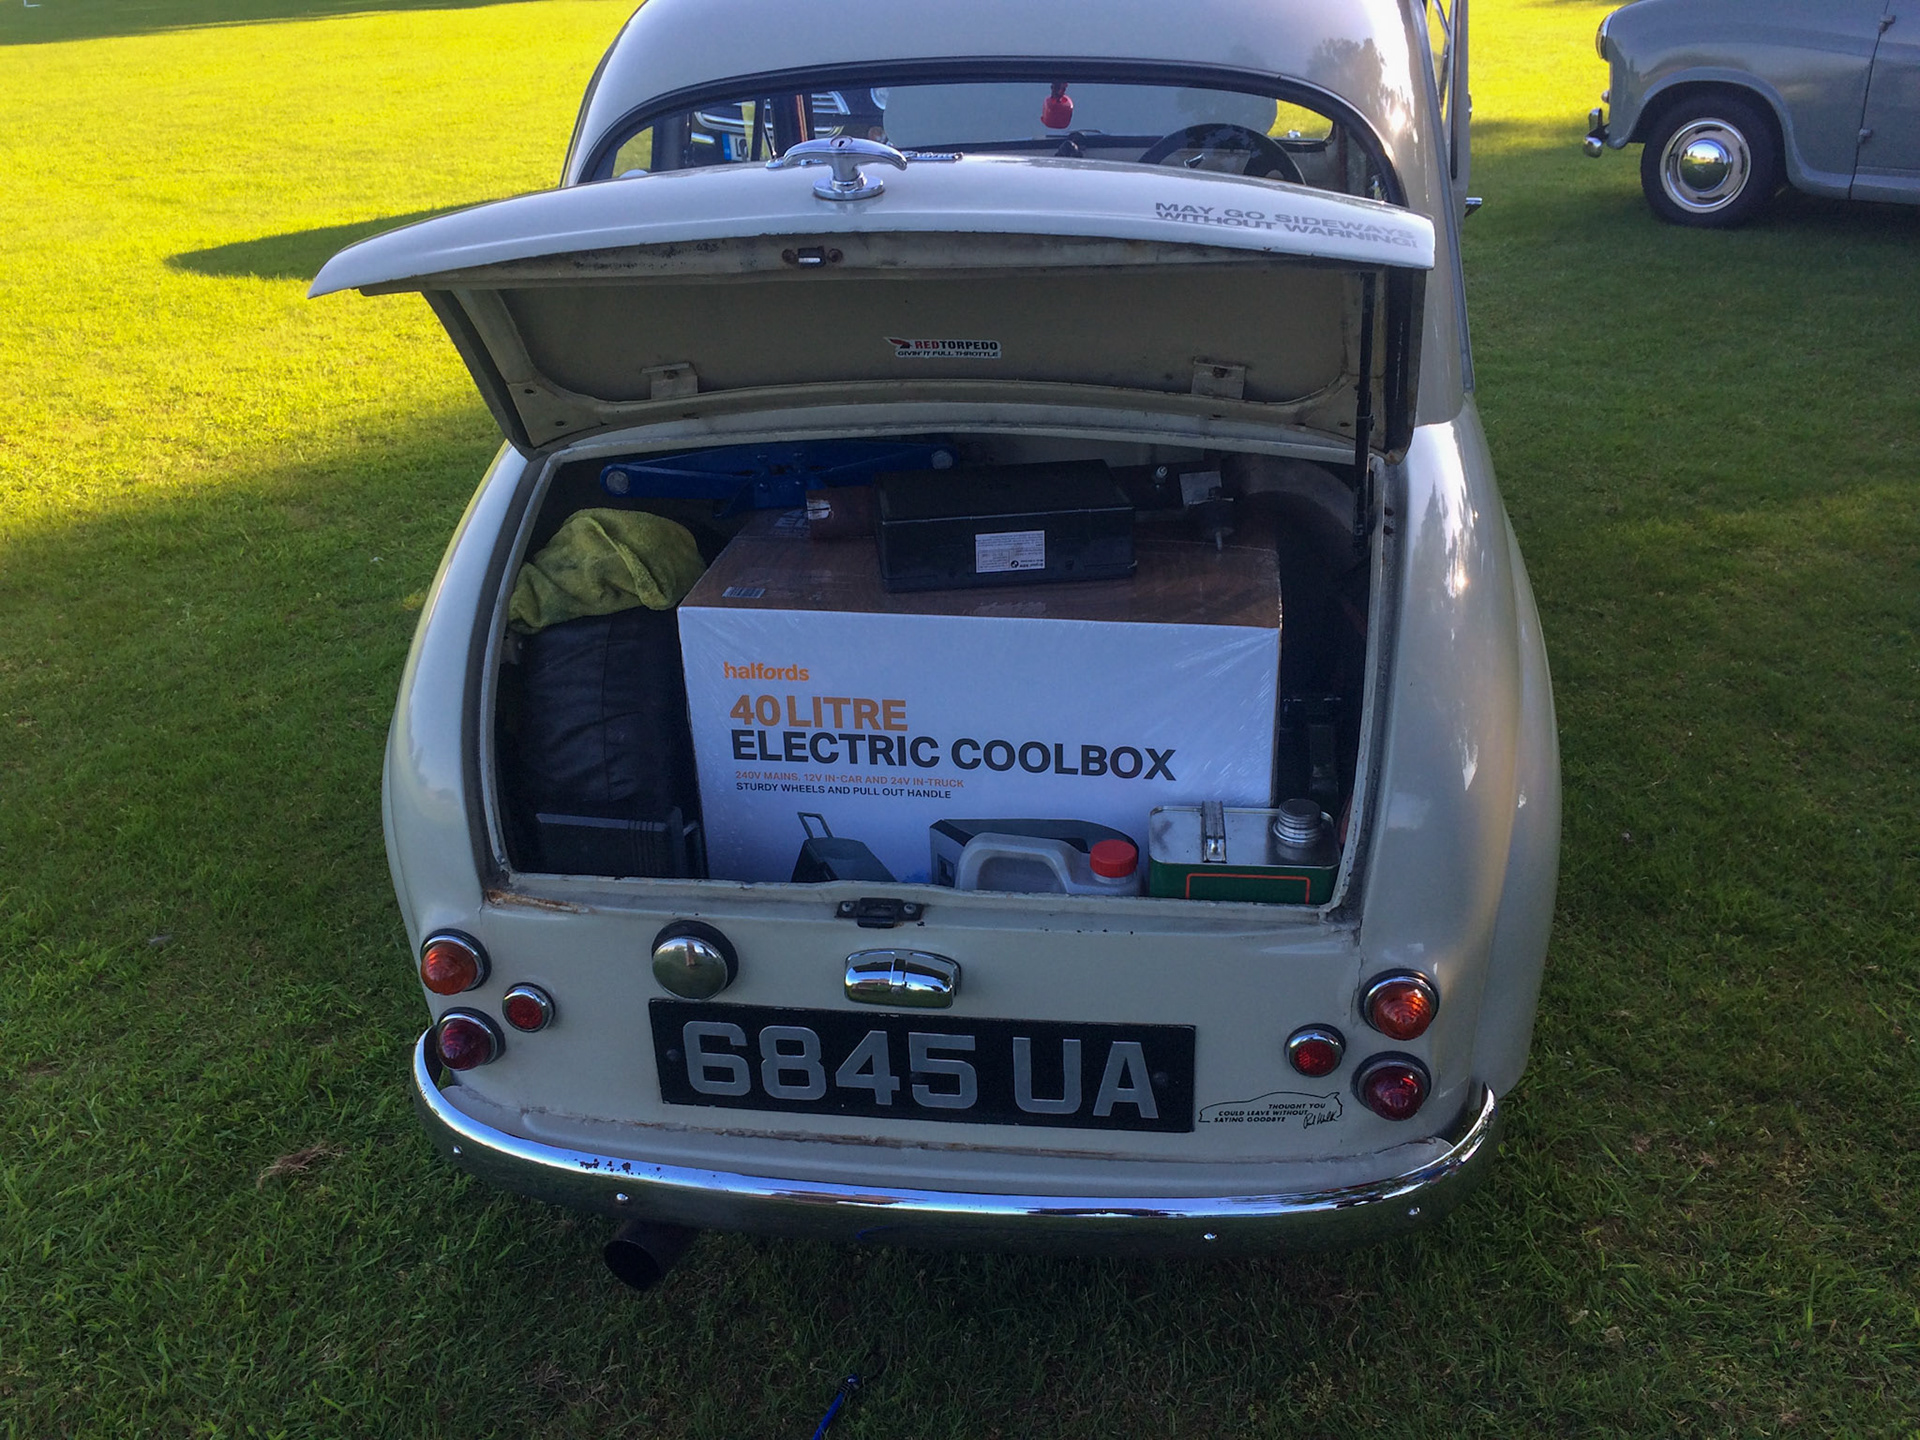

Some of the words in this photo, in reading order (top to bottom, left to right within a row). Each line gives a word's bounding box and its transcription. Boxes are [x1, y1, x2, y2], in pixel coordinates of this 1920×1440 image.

[1155, 202, 1214, 215] MAY
[1224, 209, 1265, 220] GO
[1275, 213, 1415, 239] SIDEWAYS
[1156, 211, 1276, 230] WITHOUT
[1284, 223, 1418, 249] WARNING!
[914, 340, 998, 350] REDTORPEDO
[955, 350, 998, 358] THROTTLE
[723, 661, 810, 681] halfords
[730, 694, 781, 727] 40
[786, 695, 908, 731] LITRE
[731, 729, 940, 768] ELECTRIC
[951, 738, 1177, 781] COOLBOX
[735, 770, 761, 780] 240V
[763, 771, 801, 782] MAINS,
[804, 773, 823, 783] 12V
[825, 774, 863, 784] IN-CAR
[865, 776, 888, 785] AND
[890, 776, 910, 786] 24V
[913, 777, 964, 788] IN-TRUCK
[736, 782, 778, 792] STURDY
[780, 783, 825, 794] WHEELS
[828, 785, 851, 795] AND
[853, 787, 880, 796] PULL
[882, 788, 904, 797] OUT
[907, 789, 951, 799] HANDLE
[682, 1020, 978, 1110] 6845
[1012, 1036, 1160, 1120] UA
